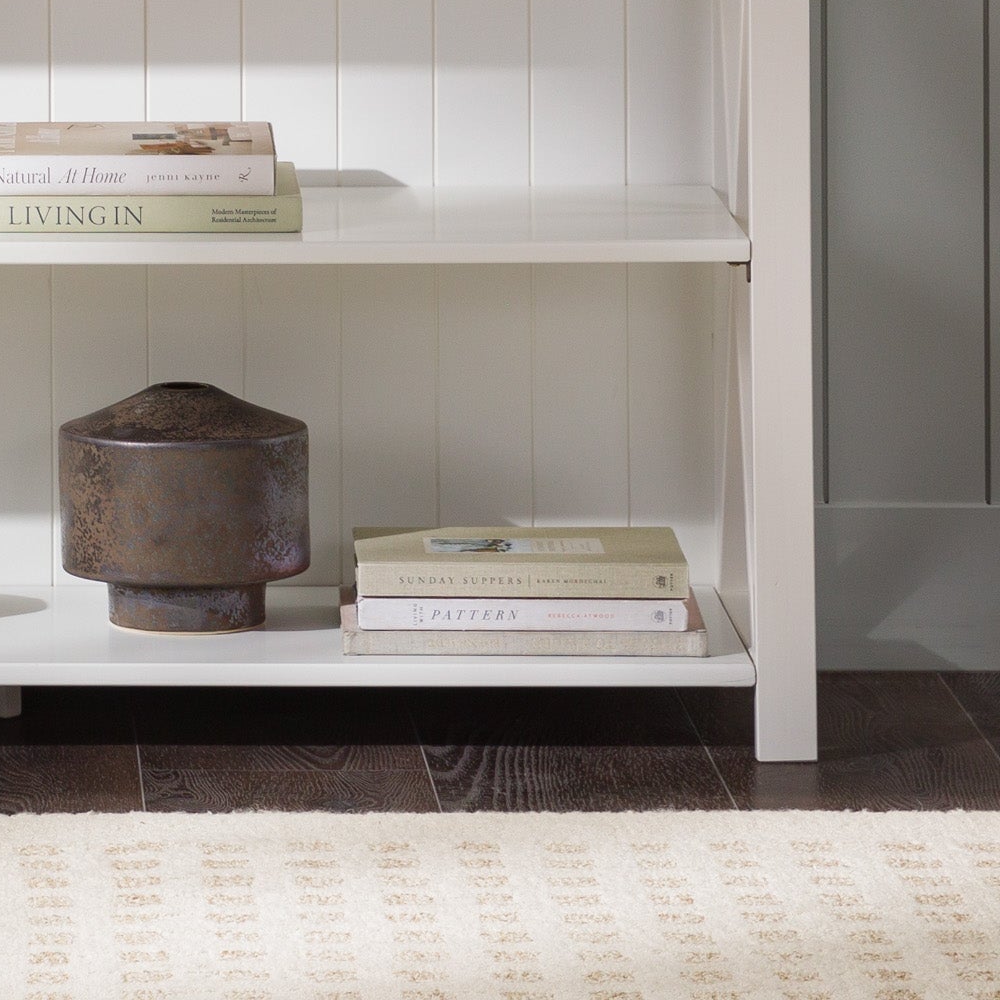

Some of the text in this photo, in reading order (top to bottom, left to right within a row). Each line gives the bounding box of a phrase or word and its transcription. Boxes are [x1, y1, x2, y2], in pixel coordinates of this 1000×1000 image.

[57, 166, 78, 185] At
[82, 167, 127, 185] Home
[211, 208, 234, 216] Modern
[270, 208, 277, 216] of
[211, 216, 277, 224] Residential Architecture
[398, 576, 523, 585] SUNDAY SUPPERS
[430, 609, 520, 621] PATTERN
